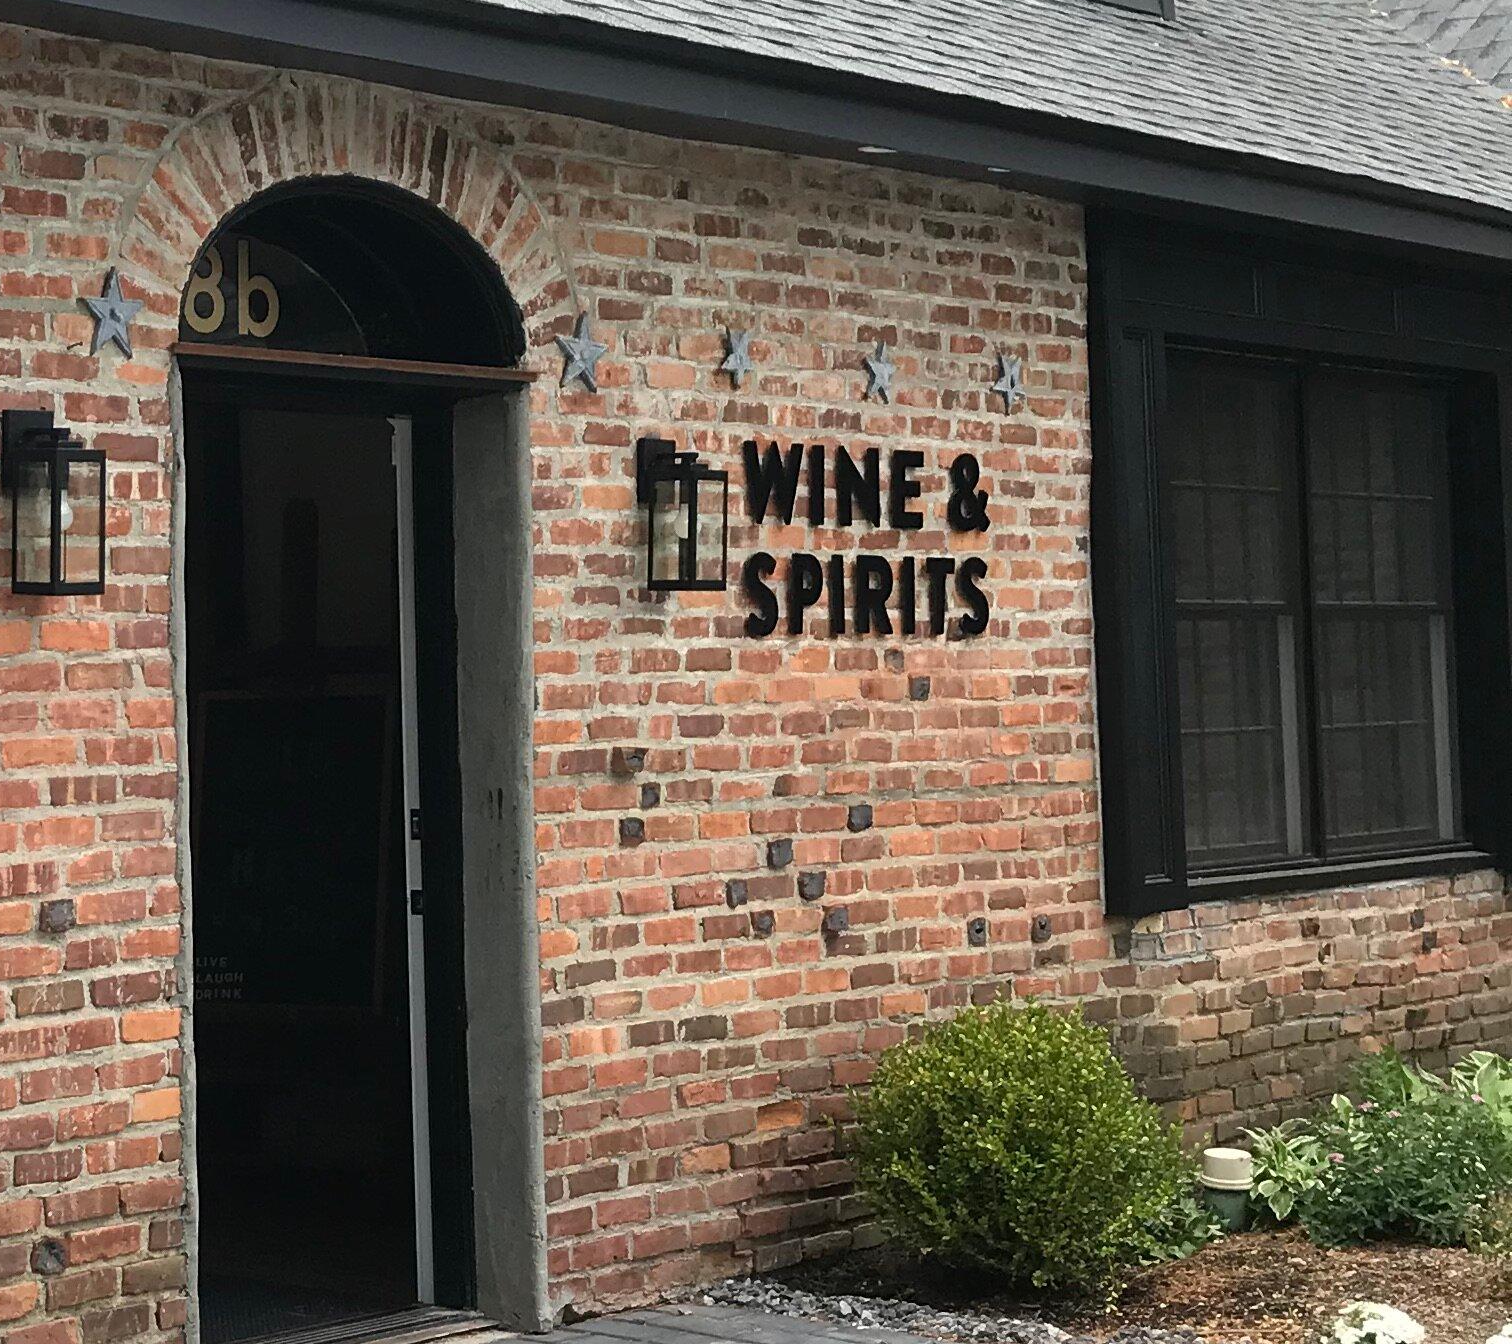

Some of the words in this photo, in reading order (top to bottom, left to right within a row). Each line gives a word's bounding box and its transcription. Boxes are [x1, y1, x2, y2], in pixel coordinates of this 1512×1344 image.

[184, 240, 280, 338] 8b
[742, 440, 925, 530] WINE
[947, 453, 991, 533] &
[744, 552, 990, 638] SPIRITS
[196, 956, 228, 968] LIVE
[196, 972, 244, 984] LAUGH
[196, 988, 243, 1000] DRINK
